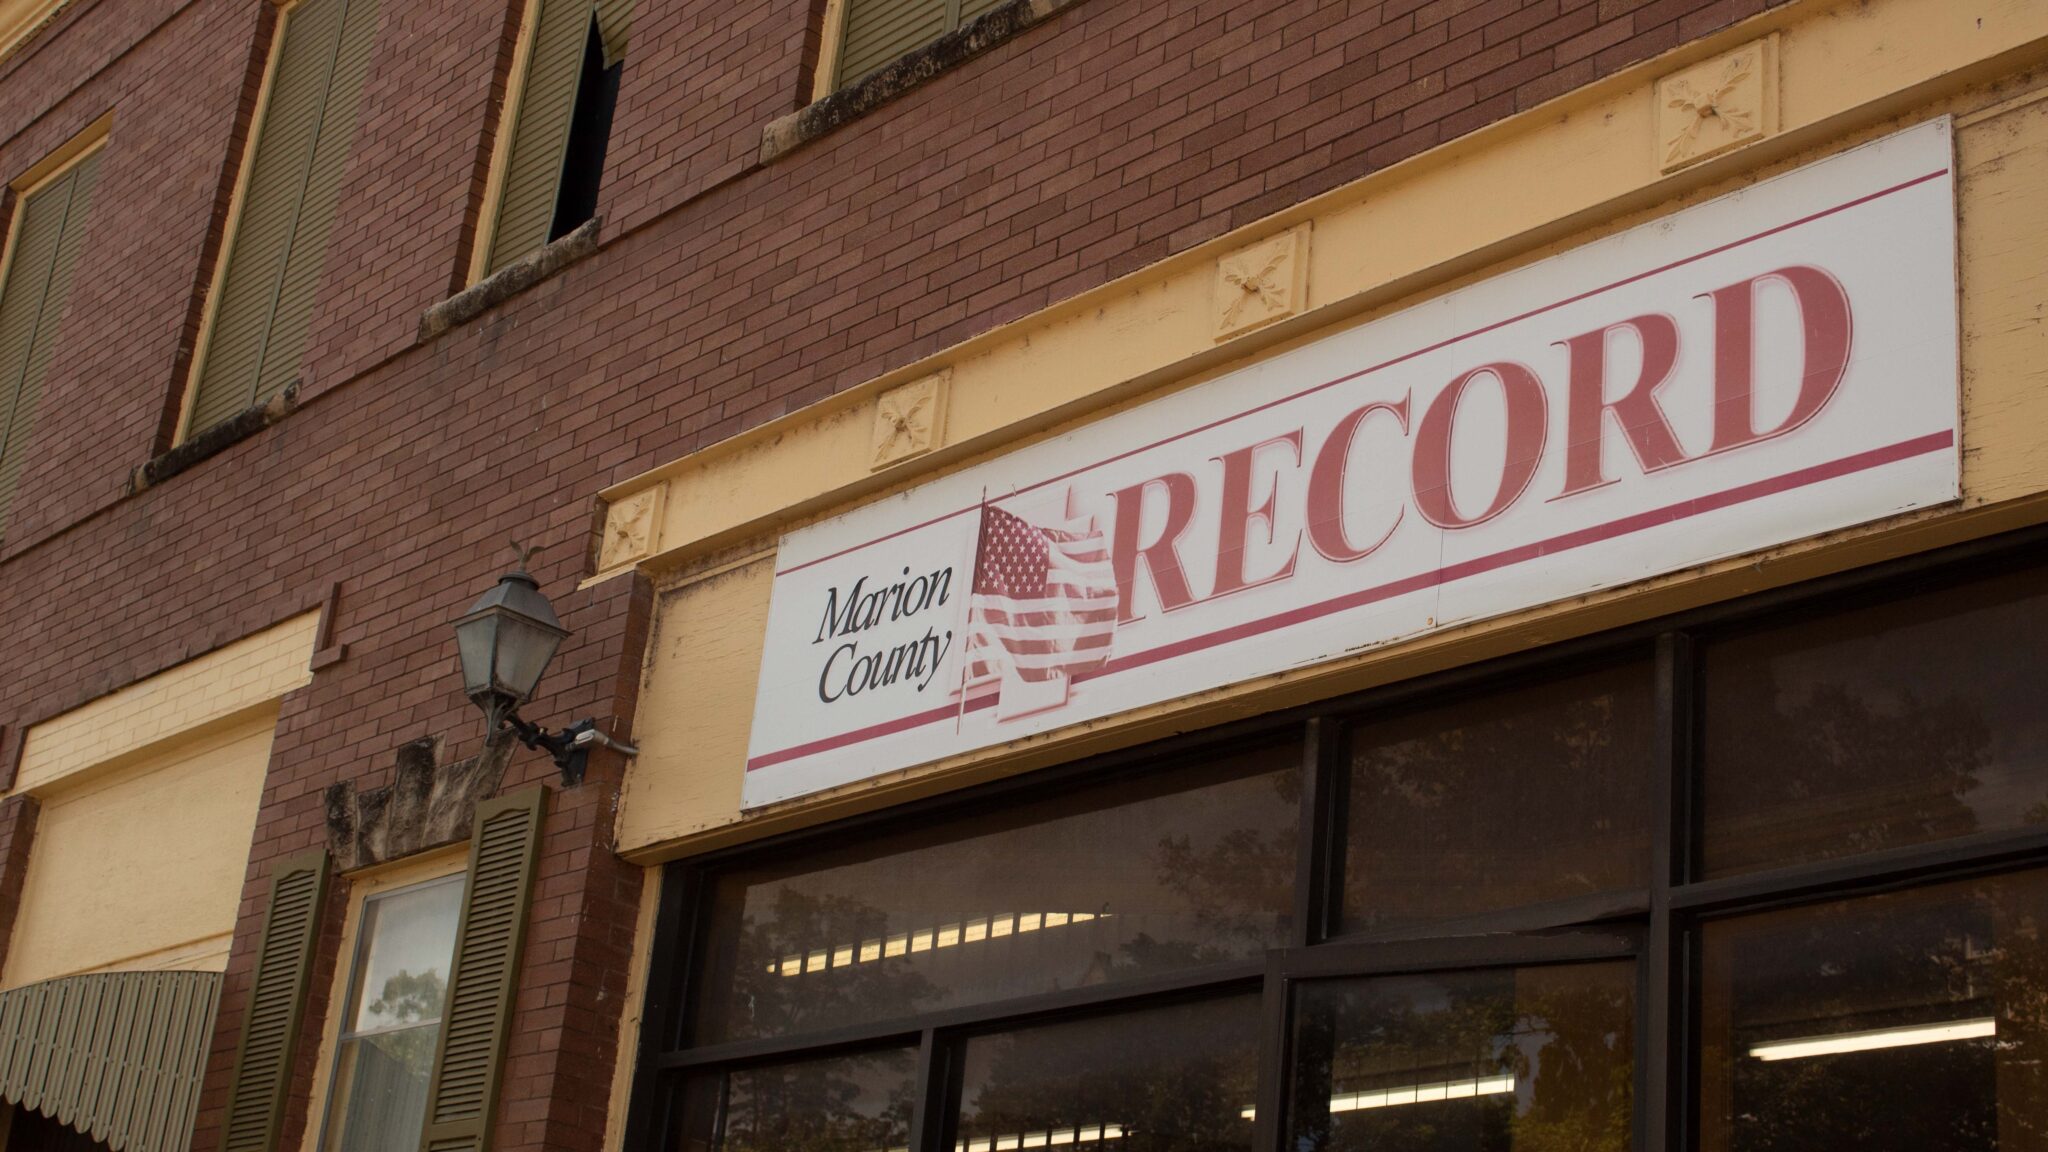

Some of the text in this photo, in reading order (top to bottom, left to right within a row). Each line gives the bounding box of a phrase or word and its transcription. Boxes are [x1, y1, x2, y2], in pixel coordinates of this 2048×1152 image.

[1107, 264, 1854, 628] RECORD
[812, 566, 953, 645] Marion
[818, 626, 952, 704] County
